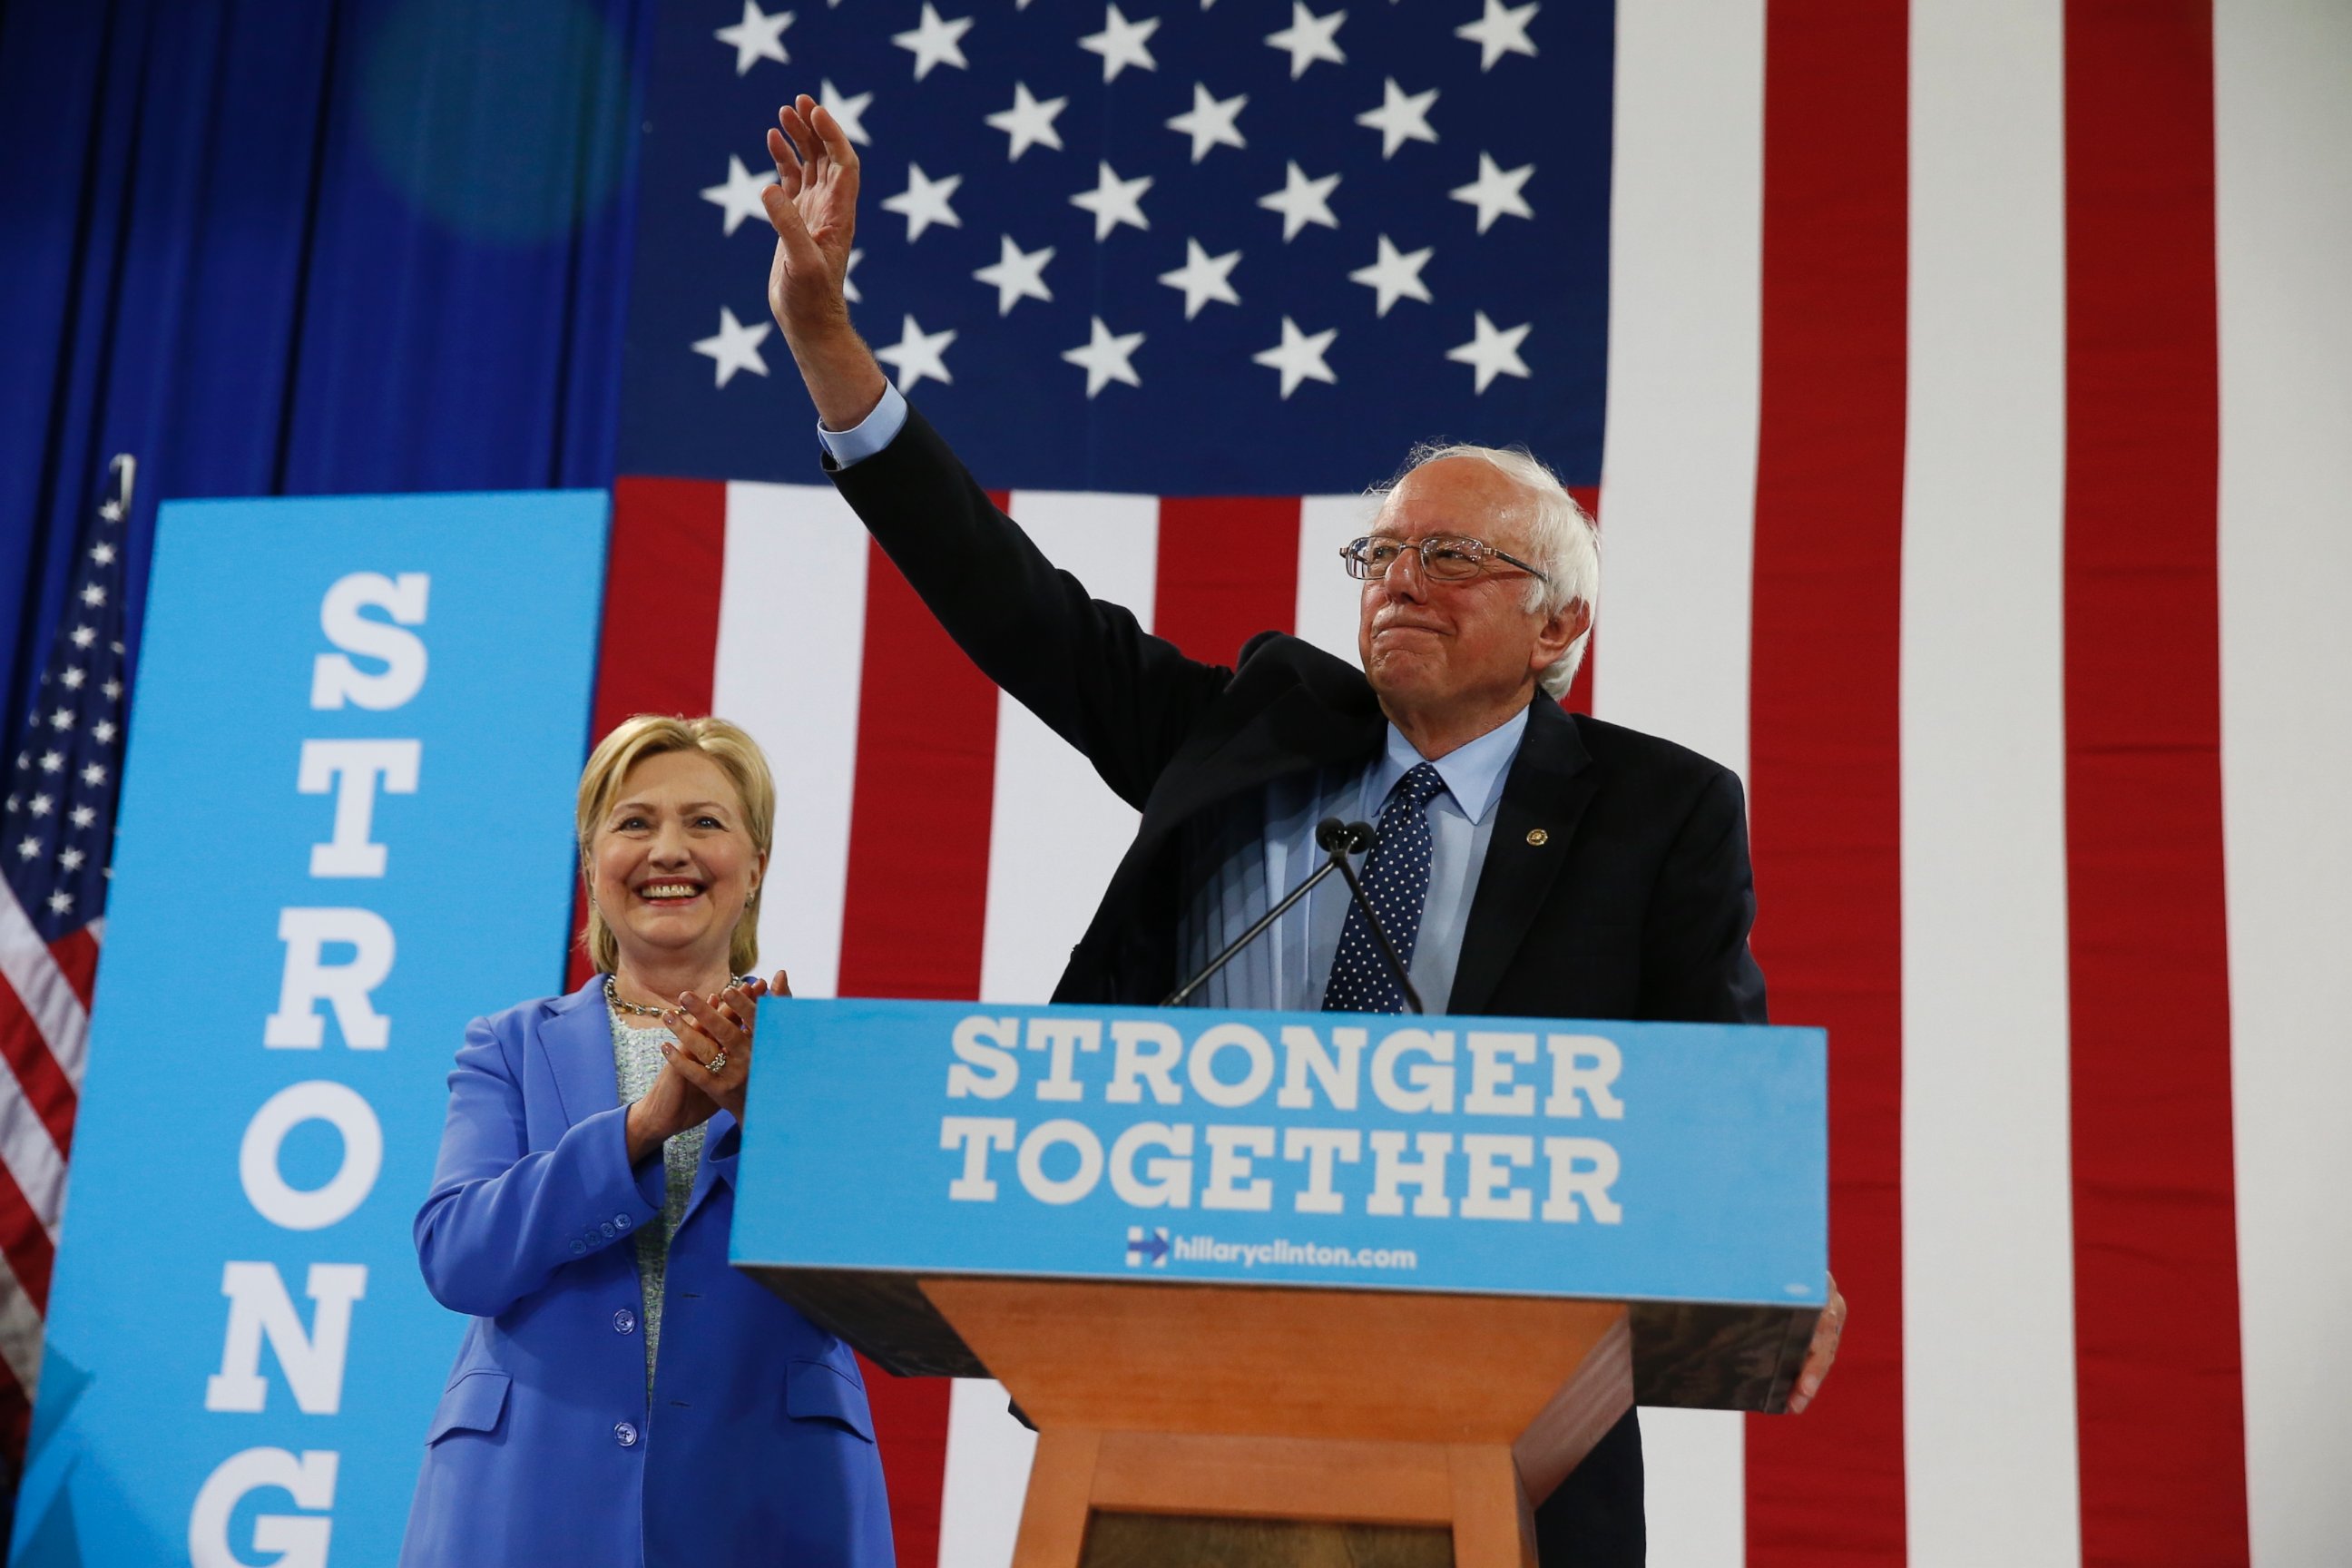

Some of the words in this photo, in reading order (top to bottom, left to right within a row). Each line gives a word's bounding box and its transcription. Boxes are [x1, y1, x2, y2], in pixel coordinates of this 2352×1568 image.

[946, 1014, 1625, 1121] STRONGER
[939, 1115, 1623, 1226] TOGETHER
[1174, 1235, 1417, 1269] hillaryclinton.com
